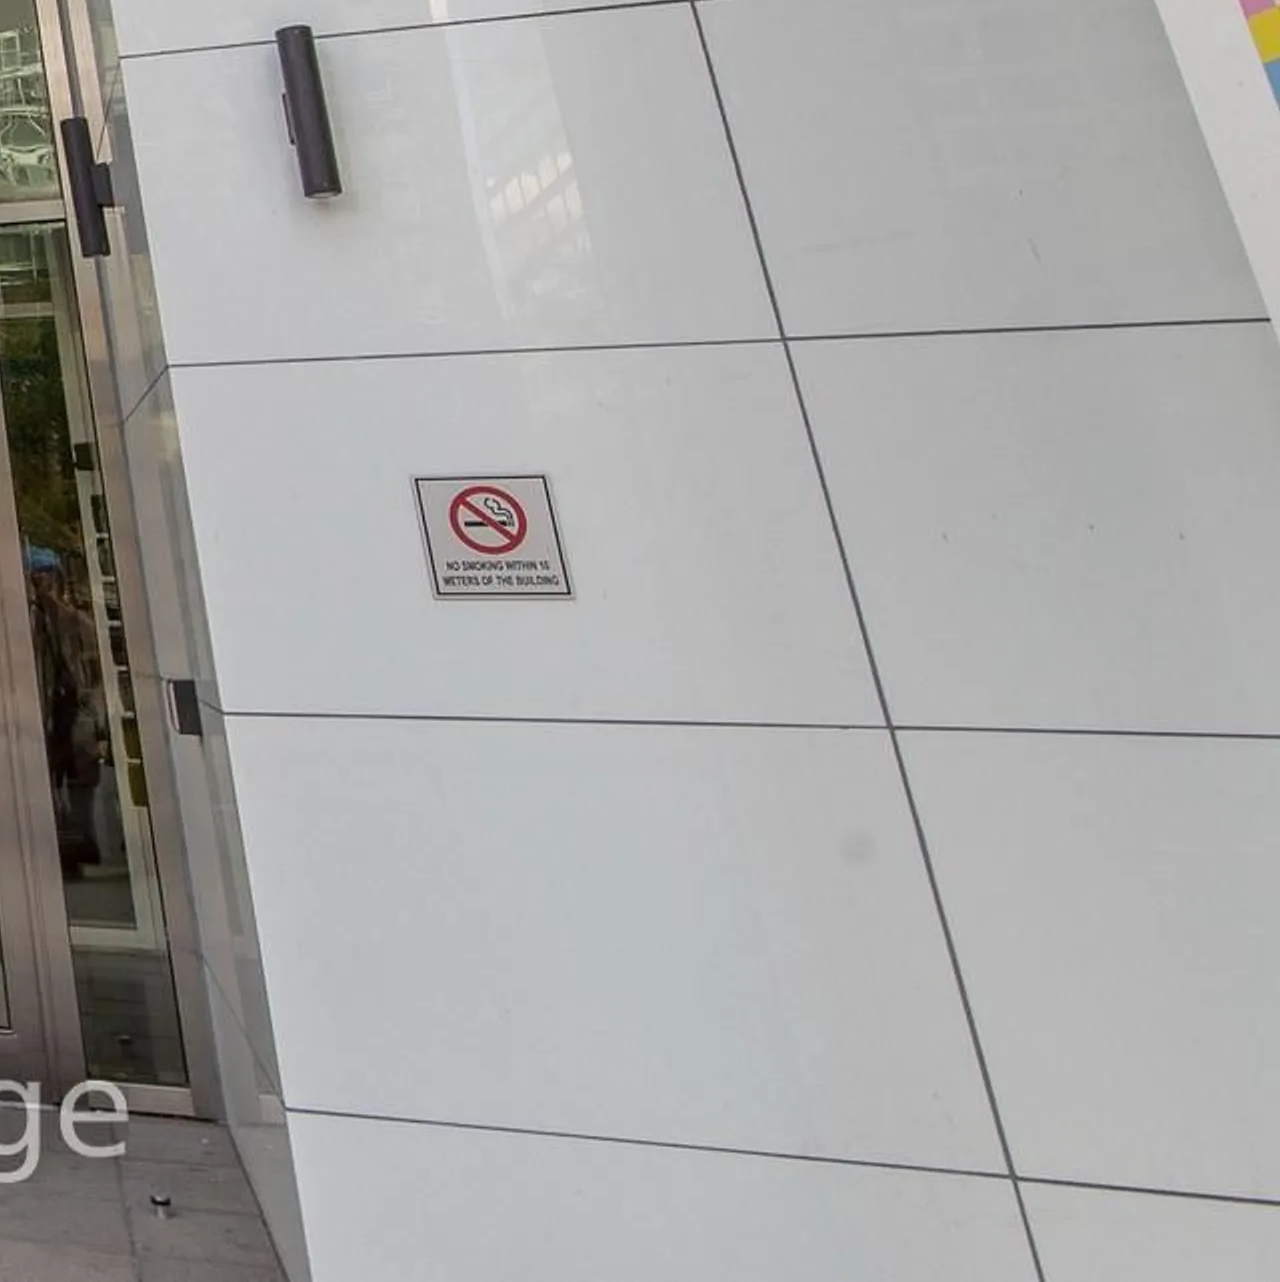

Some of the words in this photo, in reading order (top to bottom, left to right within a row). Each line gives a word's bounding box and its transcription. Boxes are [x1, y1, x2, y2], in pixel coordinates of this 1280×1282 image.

[446, 560, 460, 571] NO
[462, 560, 504, 571] SMOKING
[505, 560, 538, 571] WITHIN
[442, 576, 480, 586] METERS
[482, 576, 493, 586] OF
[496, 575, 514, 586] THE
[516, 575, 559, 586] BUILDING
